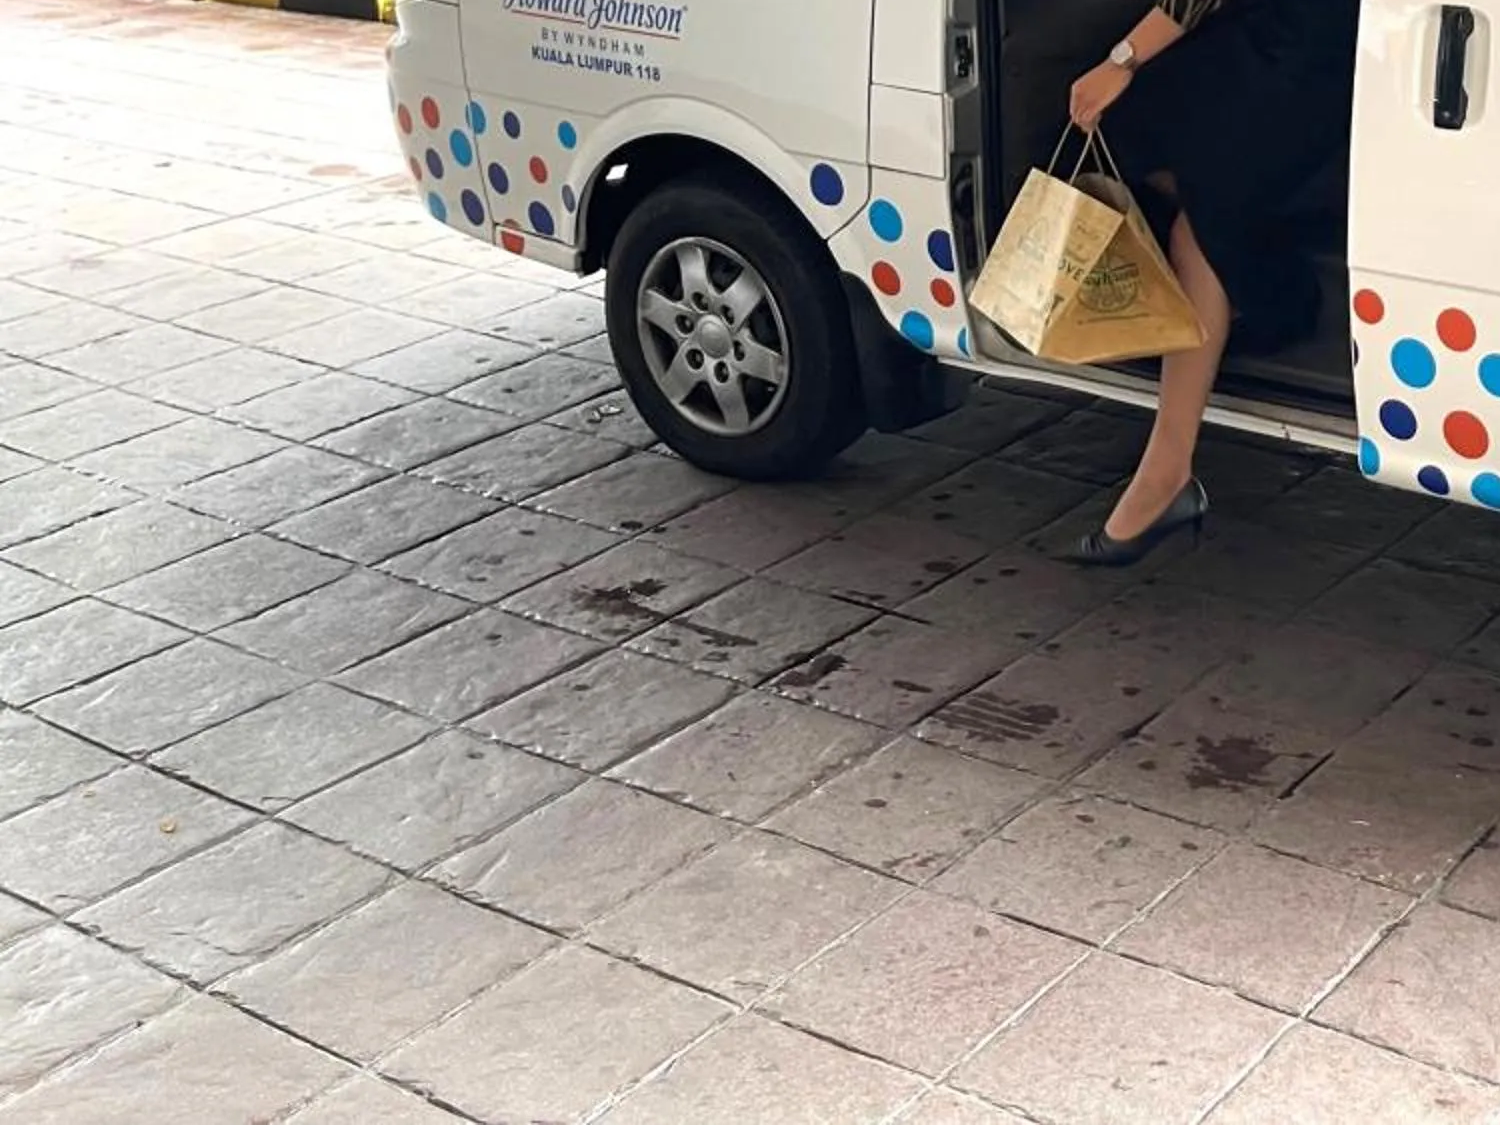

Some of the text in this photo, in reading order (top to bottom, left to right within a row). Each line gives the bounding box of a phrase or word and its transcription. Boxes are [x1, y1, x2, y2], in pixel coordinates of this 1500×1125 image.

[541, 27, 645, 57] BY WYNDHAM
[532, 46, 661, 82] KUALA LUMPUR 118
